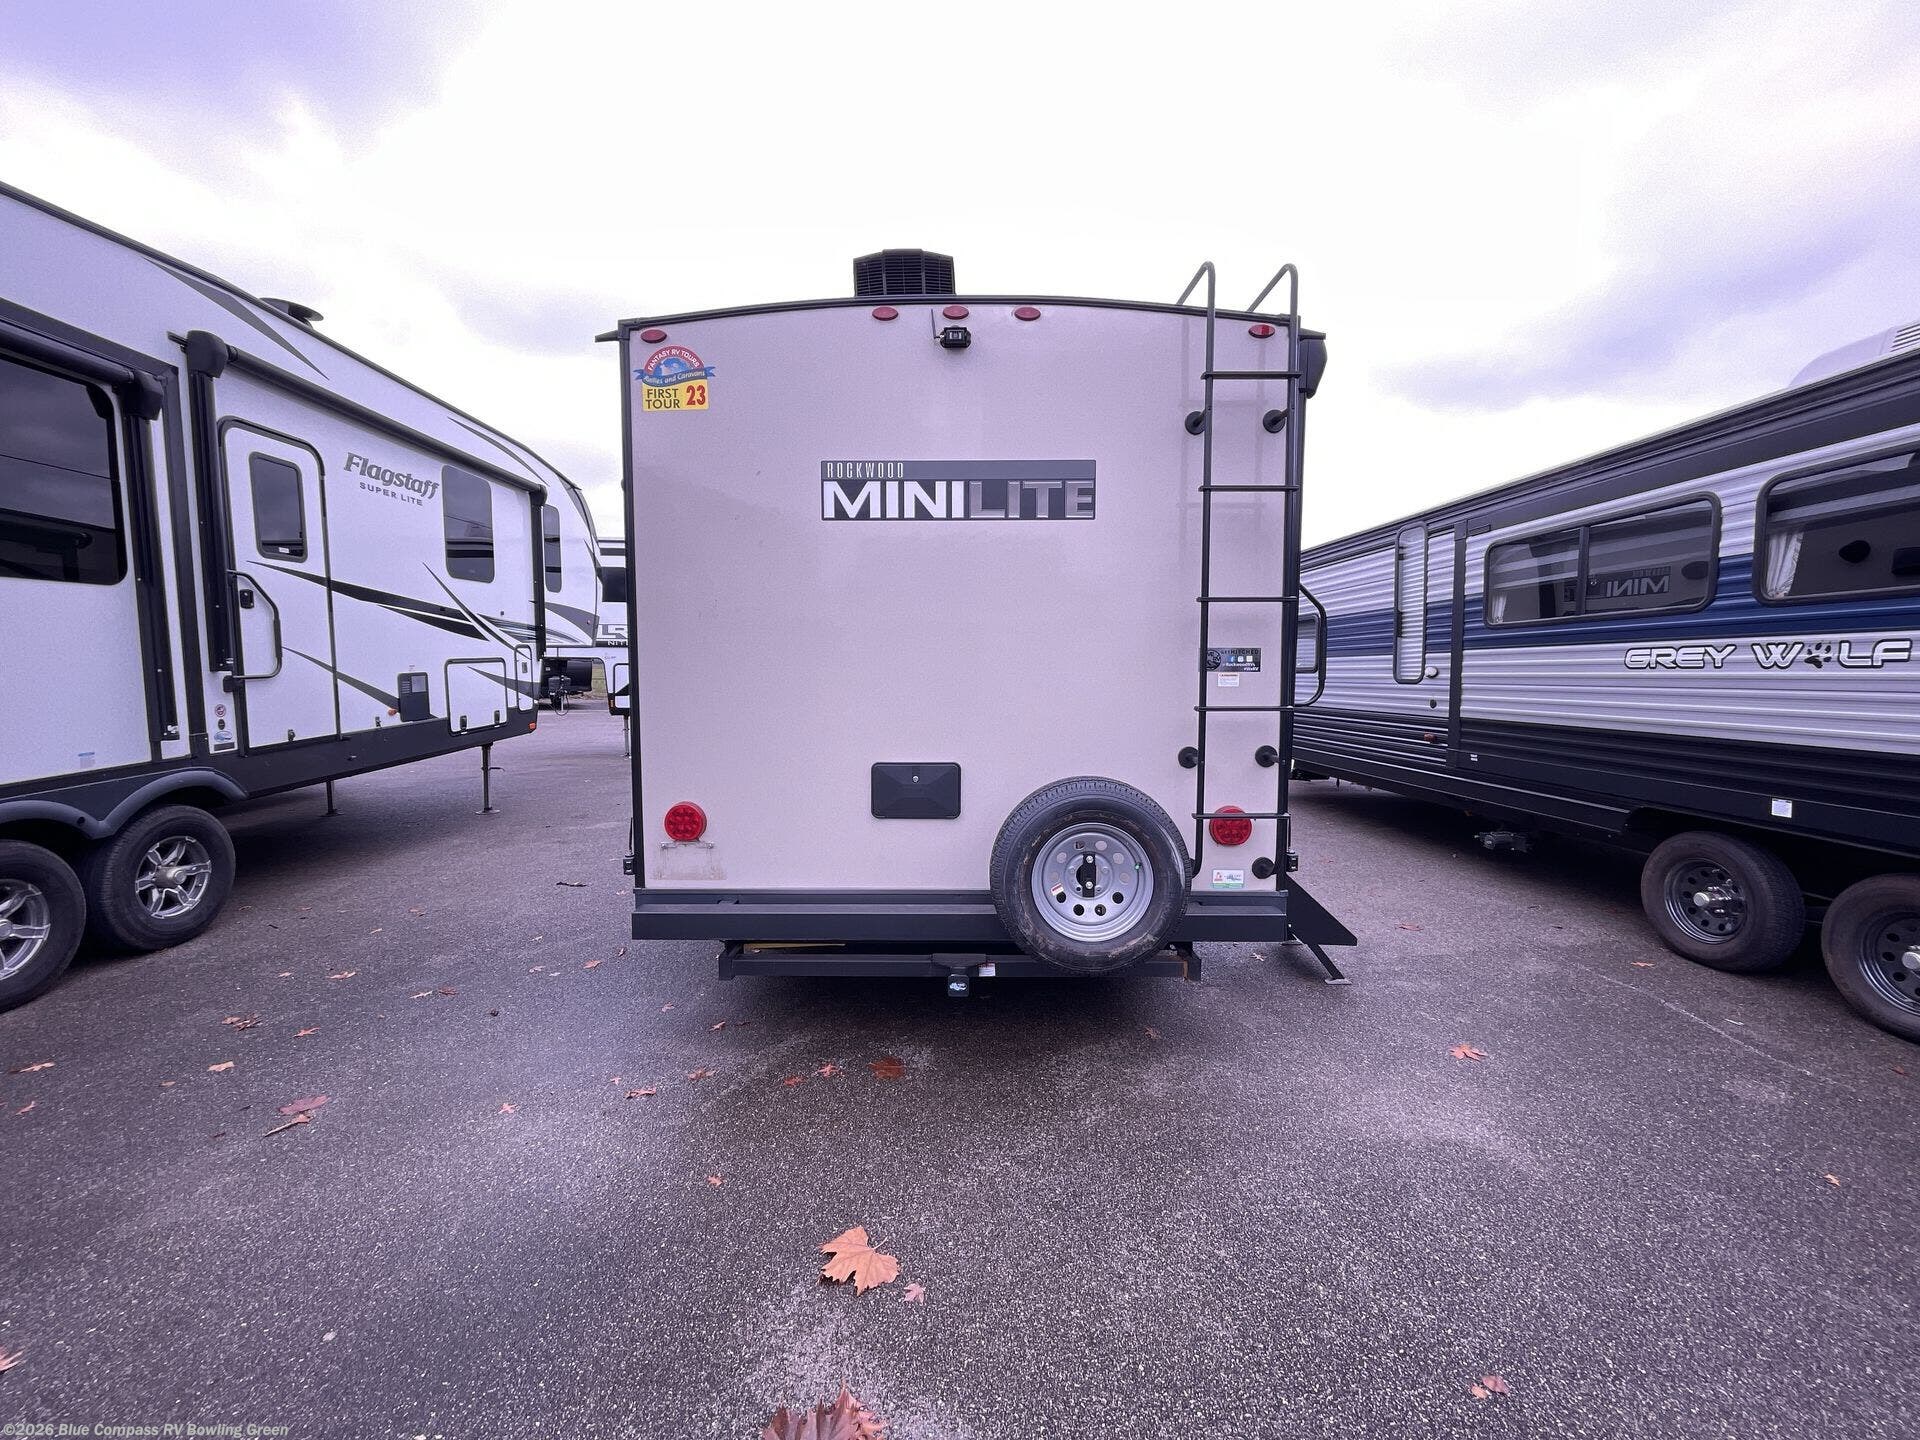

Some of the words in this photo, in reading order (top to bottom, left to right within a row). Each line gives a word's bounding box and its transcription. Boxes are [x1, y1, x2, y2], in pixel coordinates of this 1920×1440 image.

[648, 349, 671, 371] FANTASY
[681, 350, 700, 367] TOURS
[664, 375, 677, 384] and
[646, 388, 679, 399] FIRST
[686, 385, 706, 406] 23
[645, 399, 681, 410] TOUR
[343, 452, 440, 499] Flagstaff
[826, 462, 904, 479] ROCKWOOD
[359, 482, 398, 499] SUPER
[400, 494, 423, 507] LITE
[1624, 644, 1737, 670] GREY
